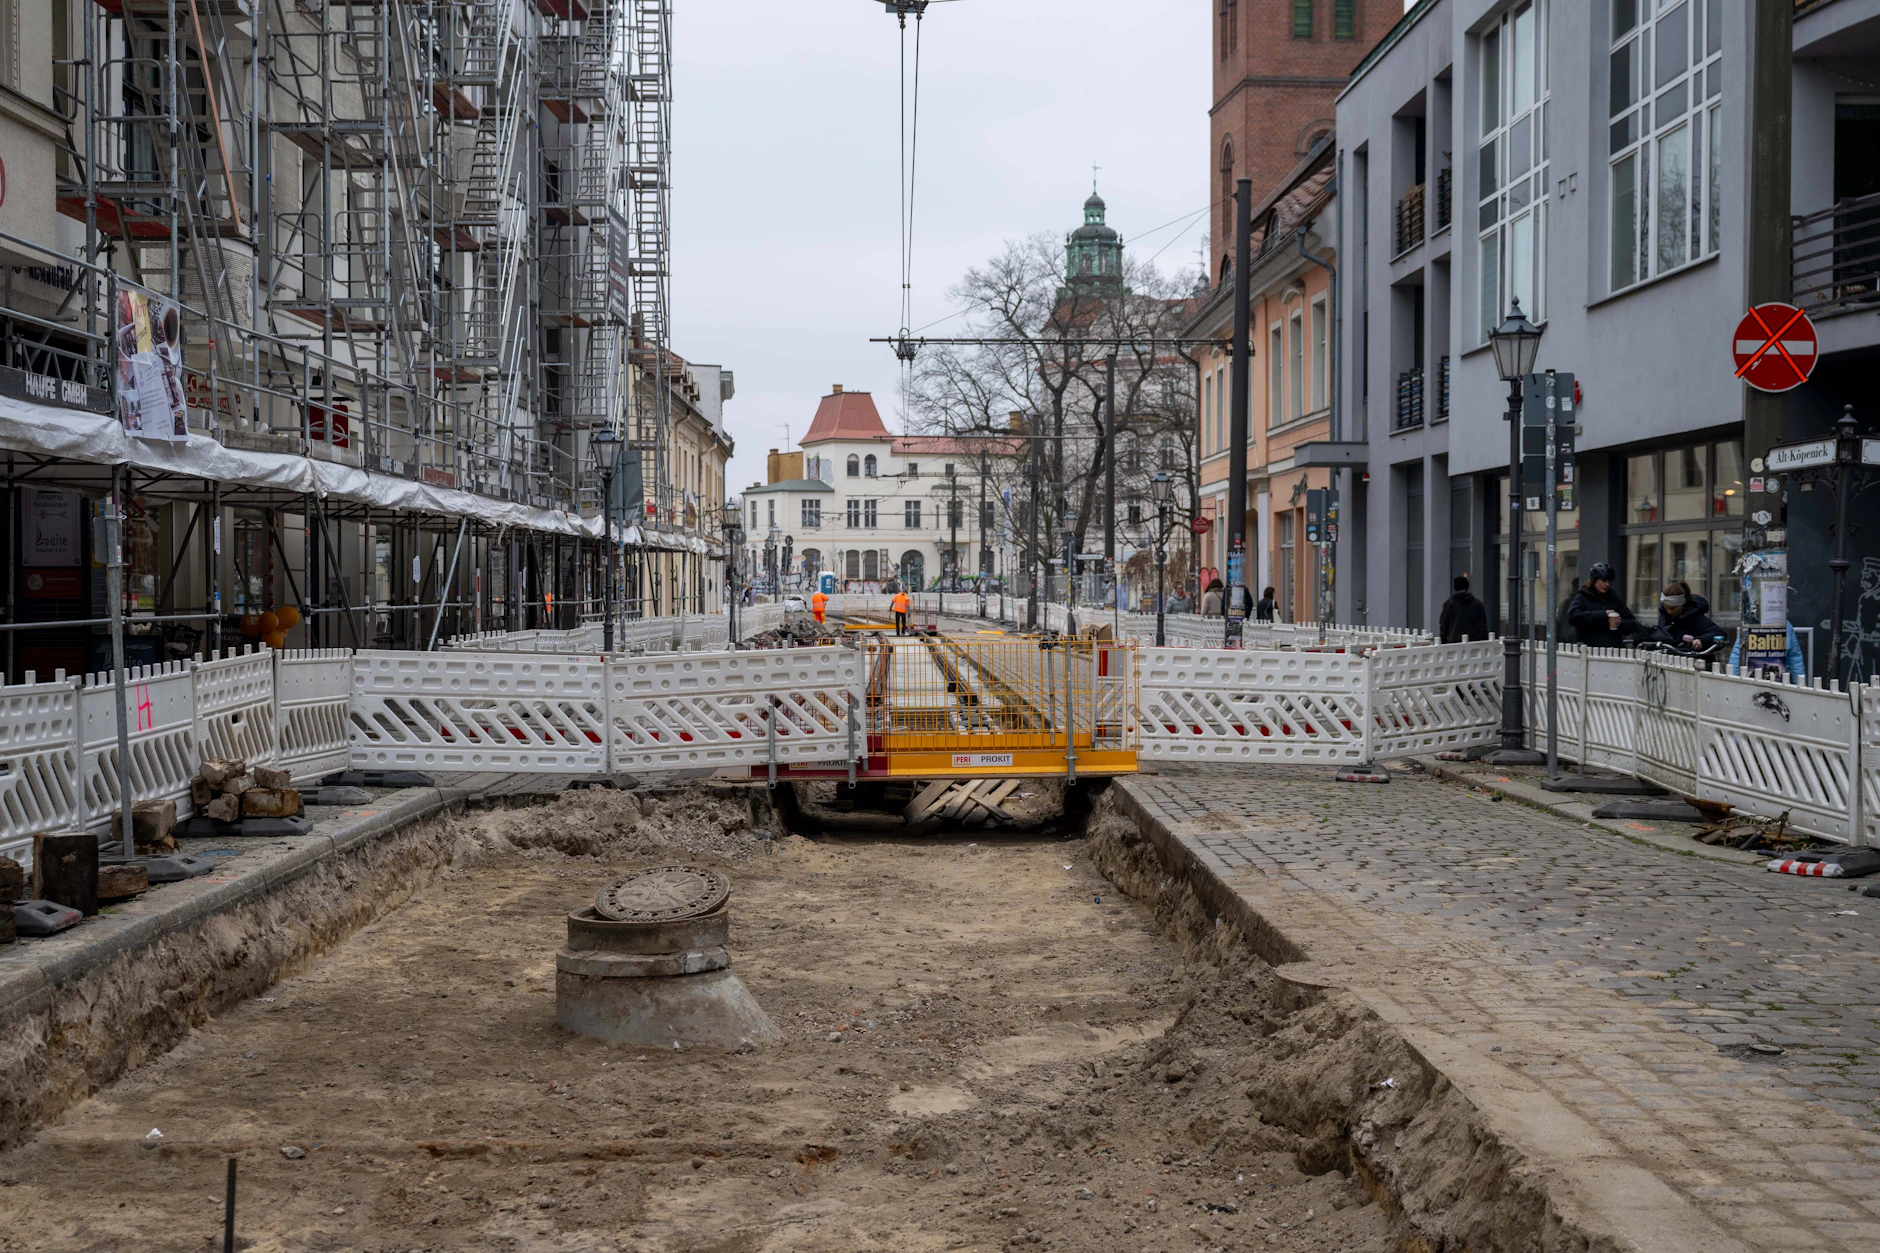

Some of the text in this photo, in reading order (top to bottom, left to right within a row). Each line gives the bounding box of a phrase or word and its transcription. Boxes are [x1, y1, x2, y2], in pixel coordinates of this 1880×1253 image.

[25, 372, 88, 406] HAUFE GMBH
[1776, 444, 1828, 463] Alt-Köpenick
[36, 493, 63, 501] Eingang
[35, 522, 68, 546] Luise
[981, 755, 1011, 763] PROKIT
